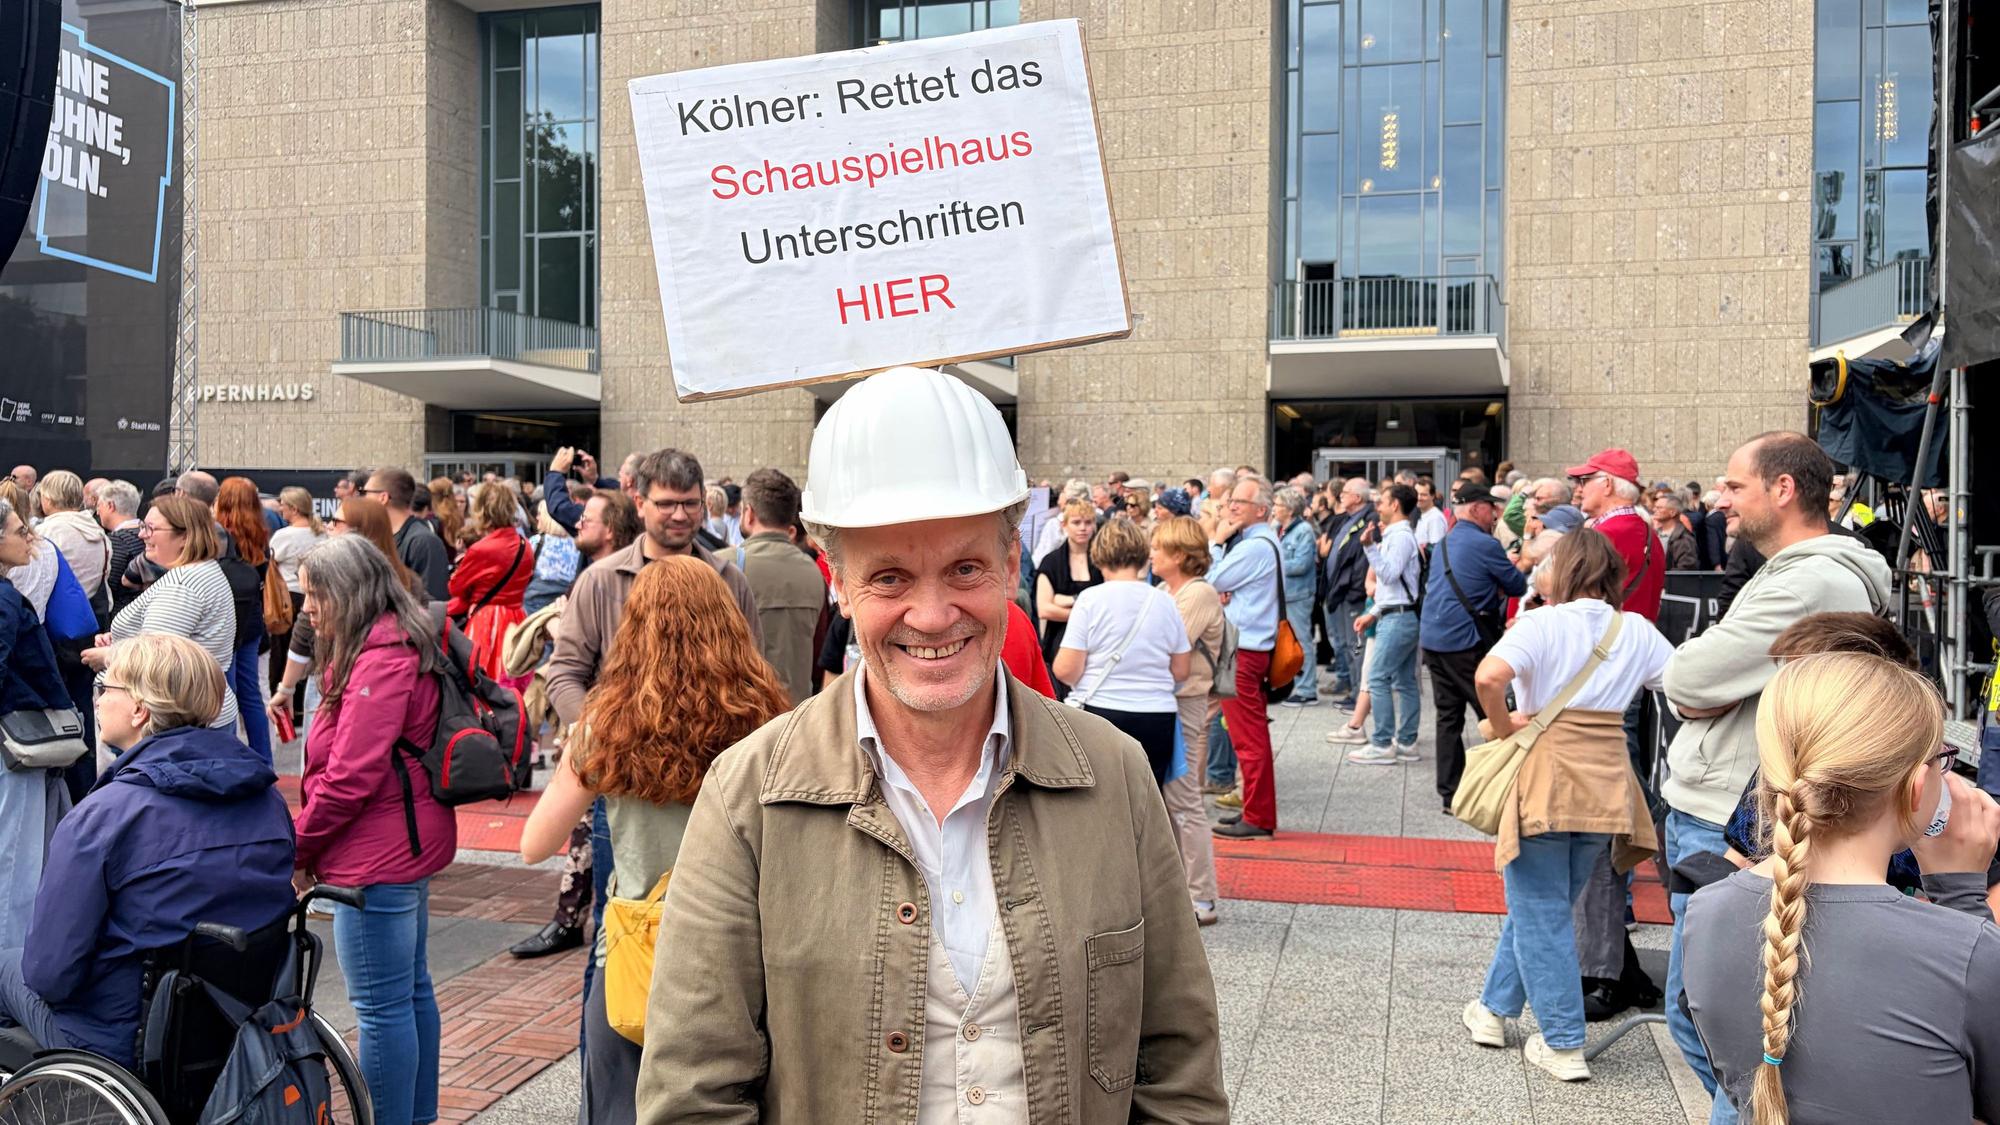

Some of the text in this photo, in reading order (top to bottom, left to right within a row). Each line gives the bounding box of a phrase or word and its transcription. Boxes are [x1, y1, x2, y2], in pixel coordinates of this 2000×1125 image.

[56, 49, 109, 105] INE
[677, 59, 1043, 136] Kölner: Rettet das
[51, 86, 131, 166] ÜHNE,
[41, 133, 108, 198] ÖLN.
[711, 131, 1032, 200] Schauspielhaus
[740, 201, 1025, 264] Unterschriften
[836, 274, 956, 325] HIER
[312, 498, 341, 518] EIN
